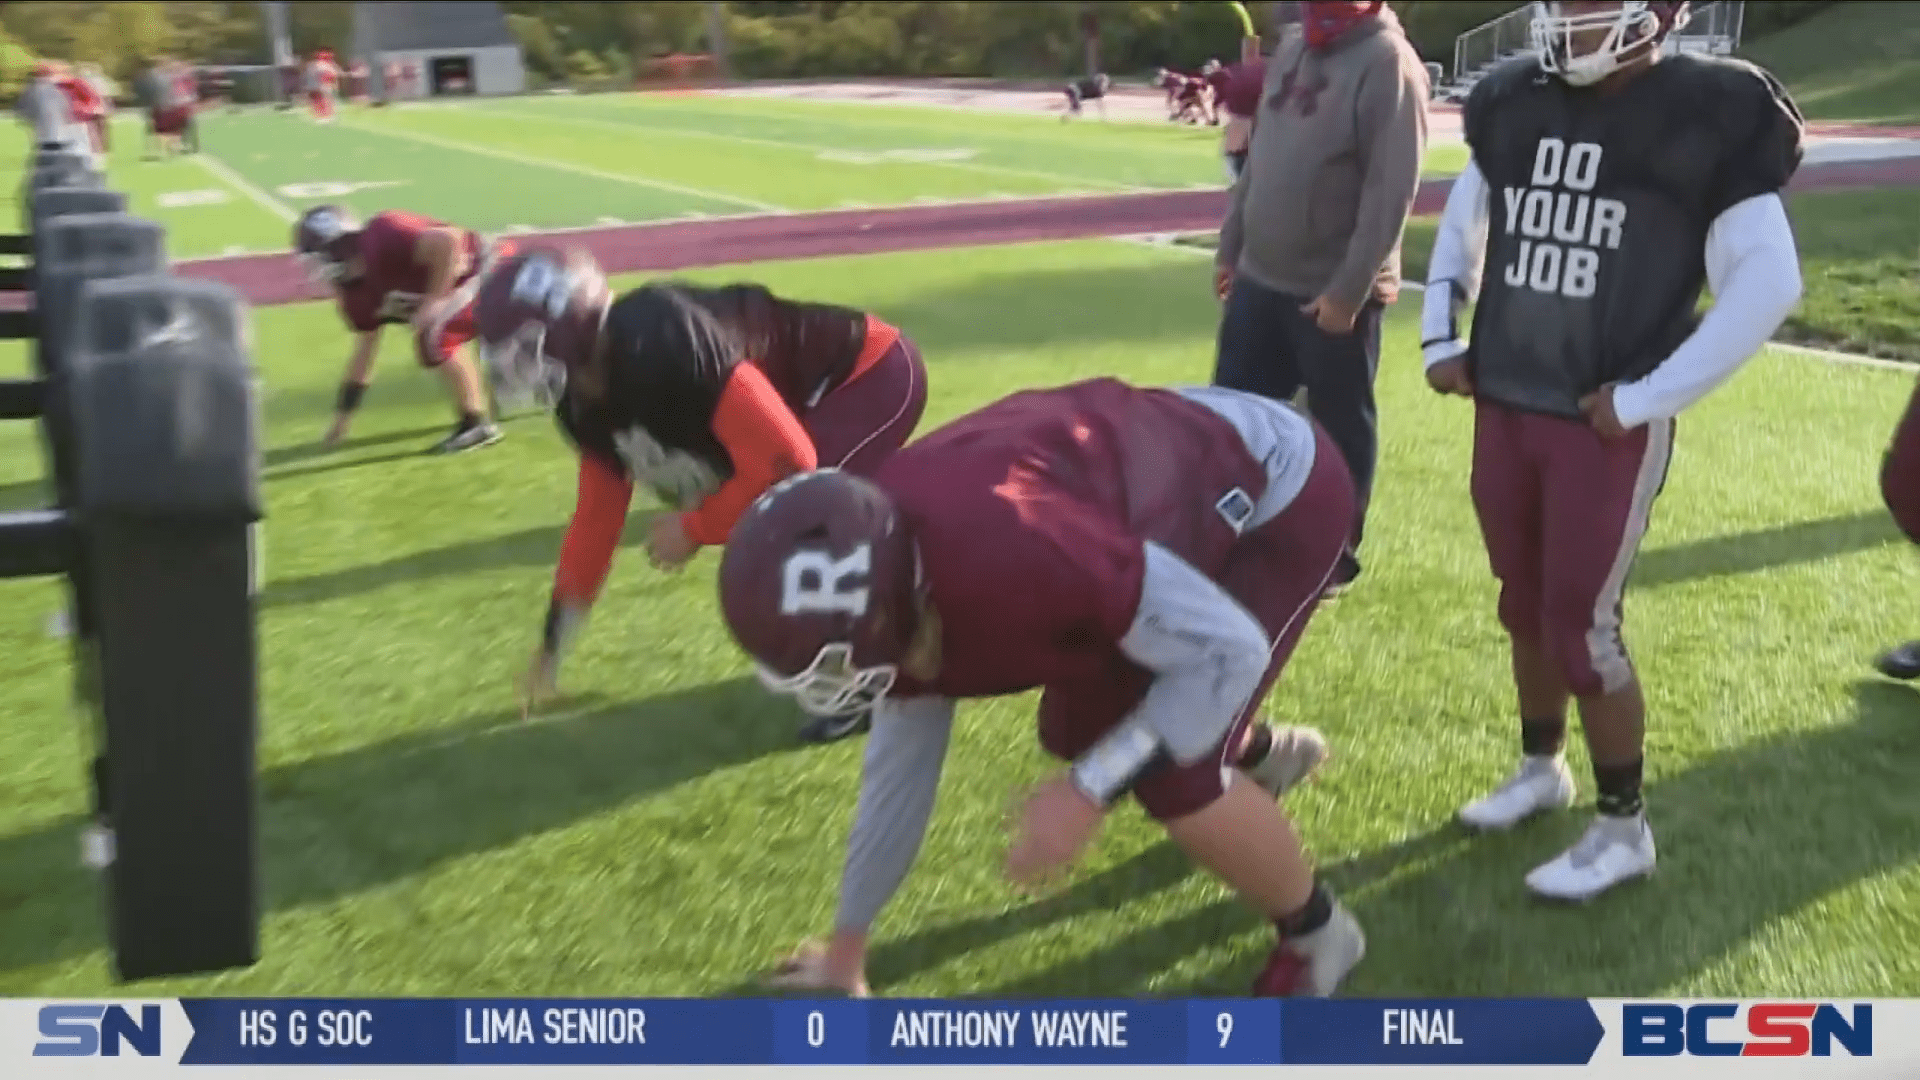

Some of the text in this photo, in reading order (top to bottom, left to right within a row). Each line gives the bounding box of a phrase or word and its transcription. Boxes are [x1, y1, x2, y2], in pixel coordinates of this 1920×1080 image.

[1531, 137, 1603, 191] DO
[1503, 186, 1627, 249] YOUR
[1504, 240, 1600, 298] JOB
[781, 542, 872, 617] R
